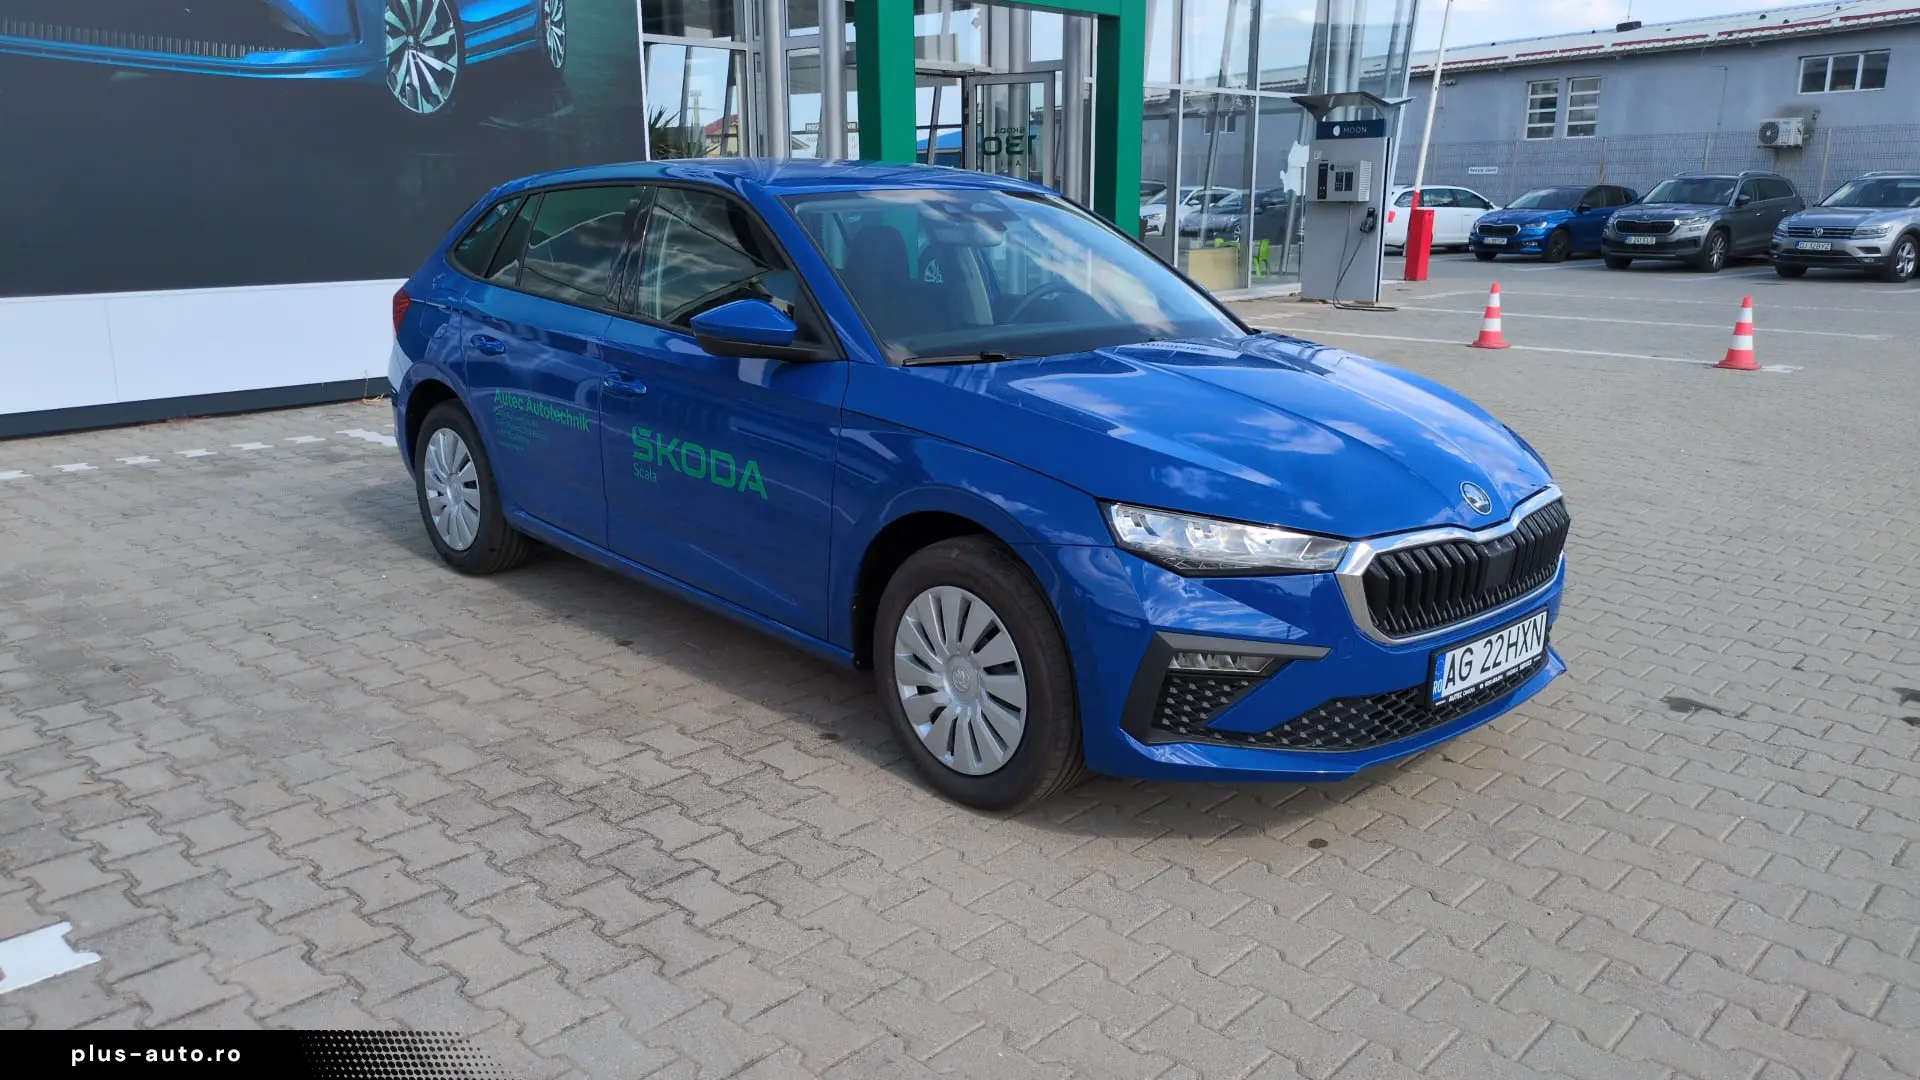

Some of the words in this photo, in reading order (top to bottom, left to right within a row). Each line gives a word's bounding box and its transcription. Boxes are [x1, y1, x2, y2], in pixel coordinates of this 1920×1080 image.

[494, 388, 525, 411] Autec
[526, 396, 590, 433] Autotechnik
[633, 462, 657, 483] Scala
[1445, 647, 1474, 690] AG
[1480, 615, 1544, 673] 22HXN
[1432, 679, 1443, 695] RO
